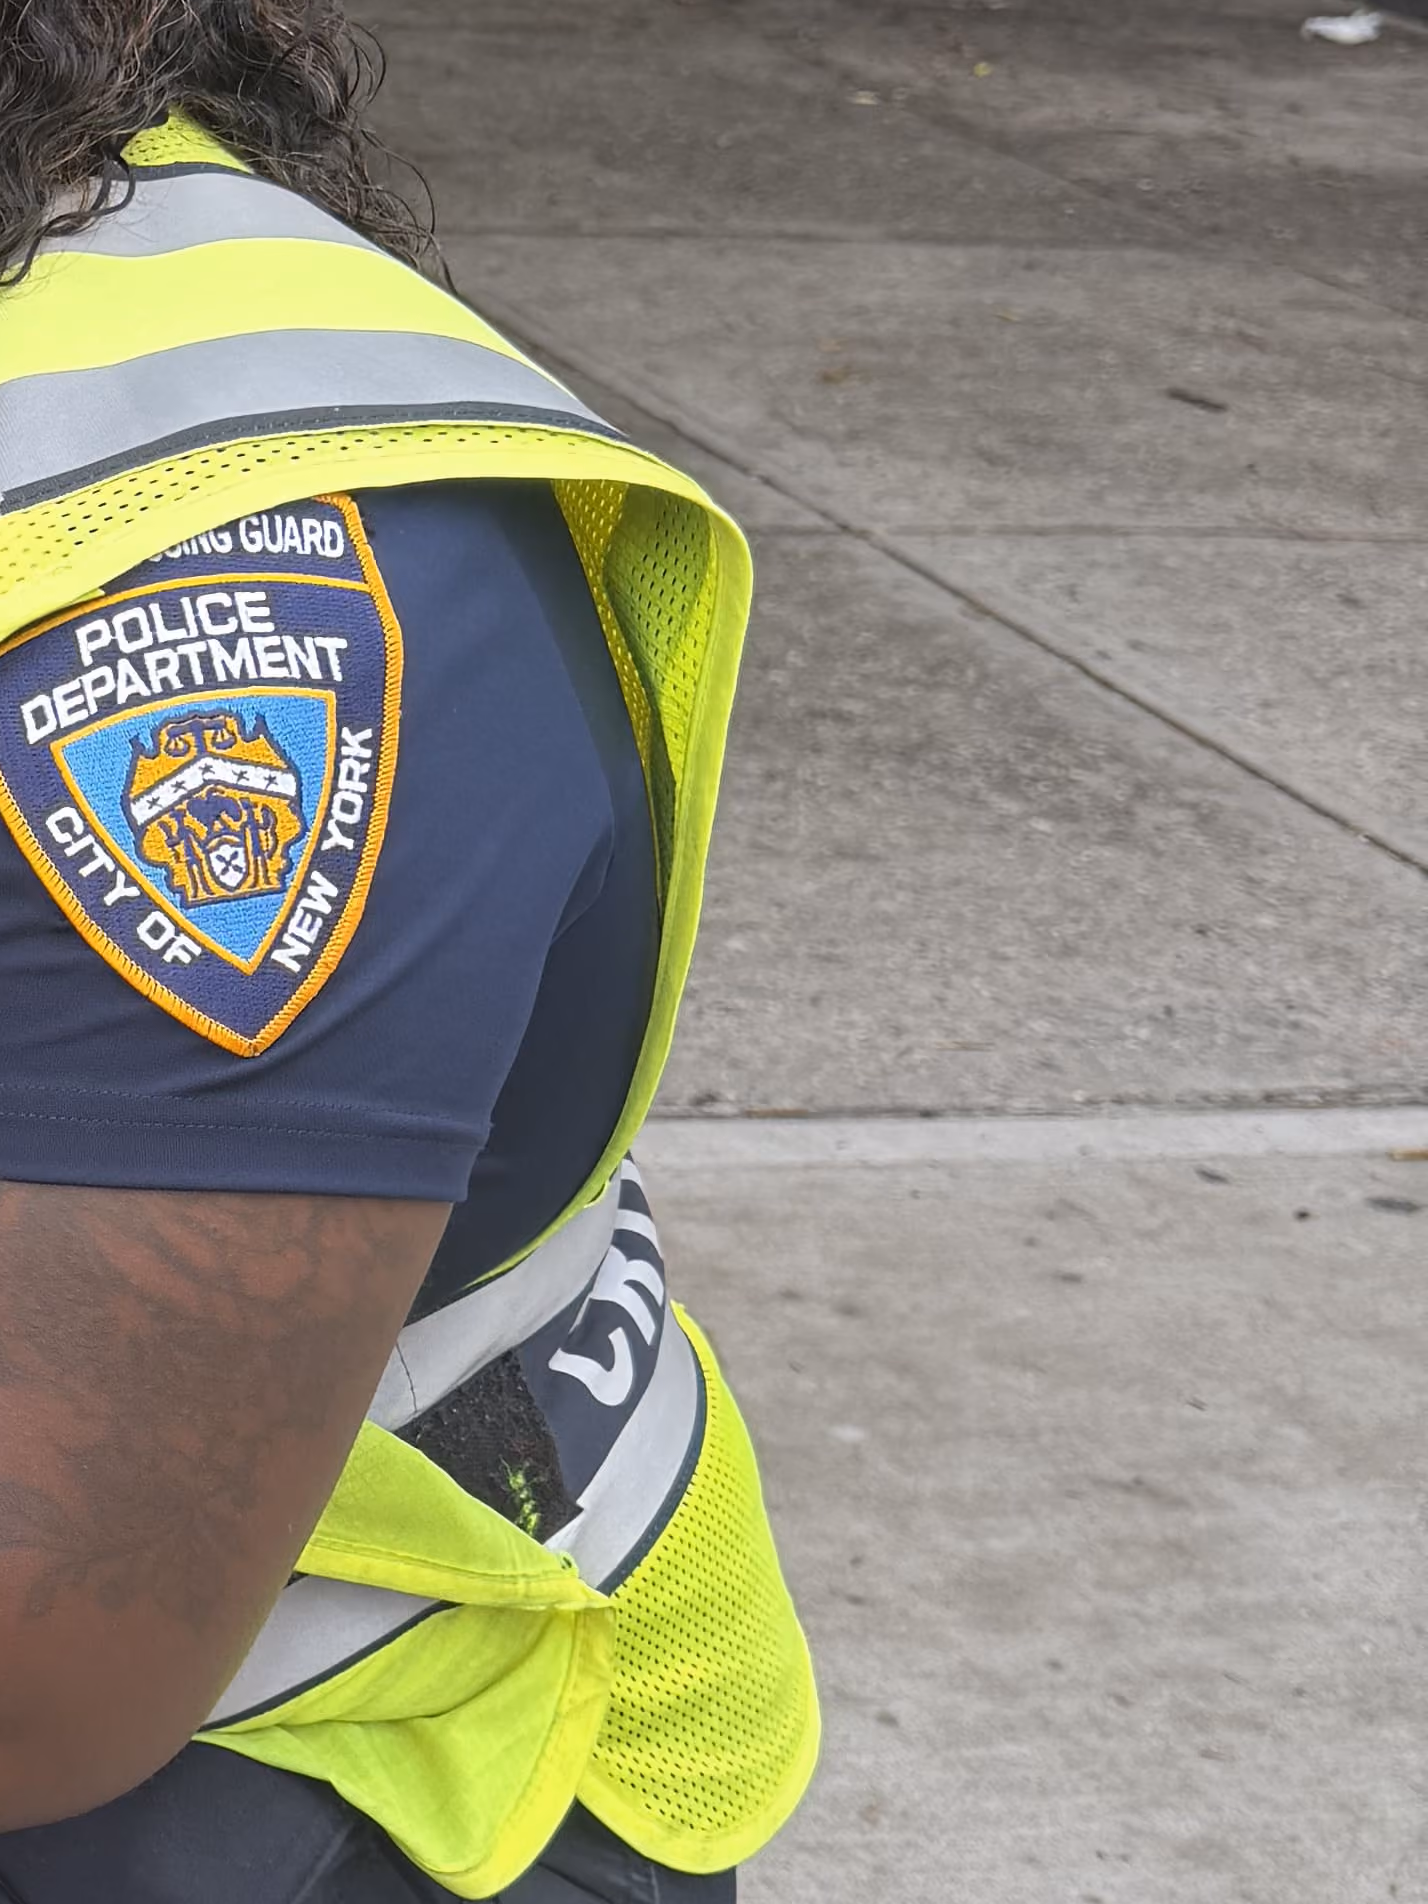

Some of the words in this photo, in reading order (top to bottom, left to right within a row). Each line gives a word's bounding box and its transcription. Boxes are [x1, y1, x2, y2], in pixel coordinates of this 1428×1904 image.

[239, 514, 344, 558] GUARD
[75, 592, 275, 666] POLICE
[20, 636, 347, 744] DEPARTMENT
[46, 807, 140, 906] CITY
[136, 910, 203, 964] OF
[270, 870, 339, 973] NEW
[321, 727, 373, 851] YORK
